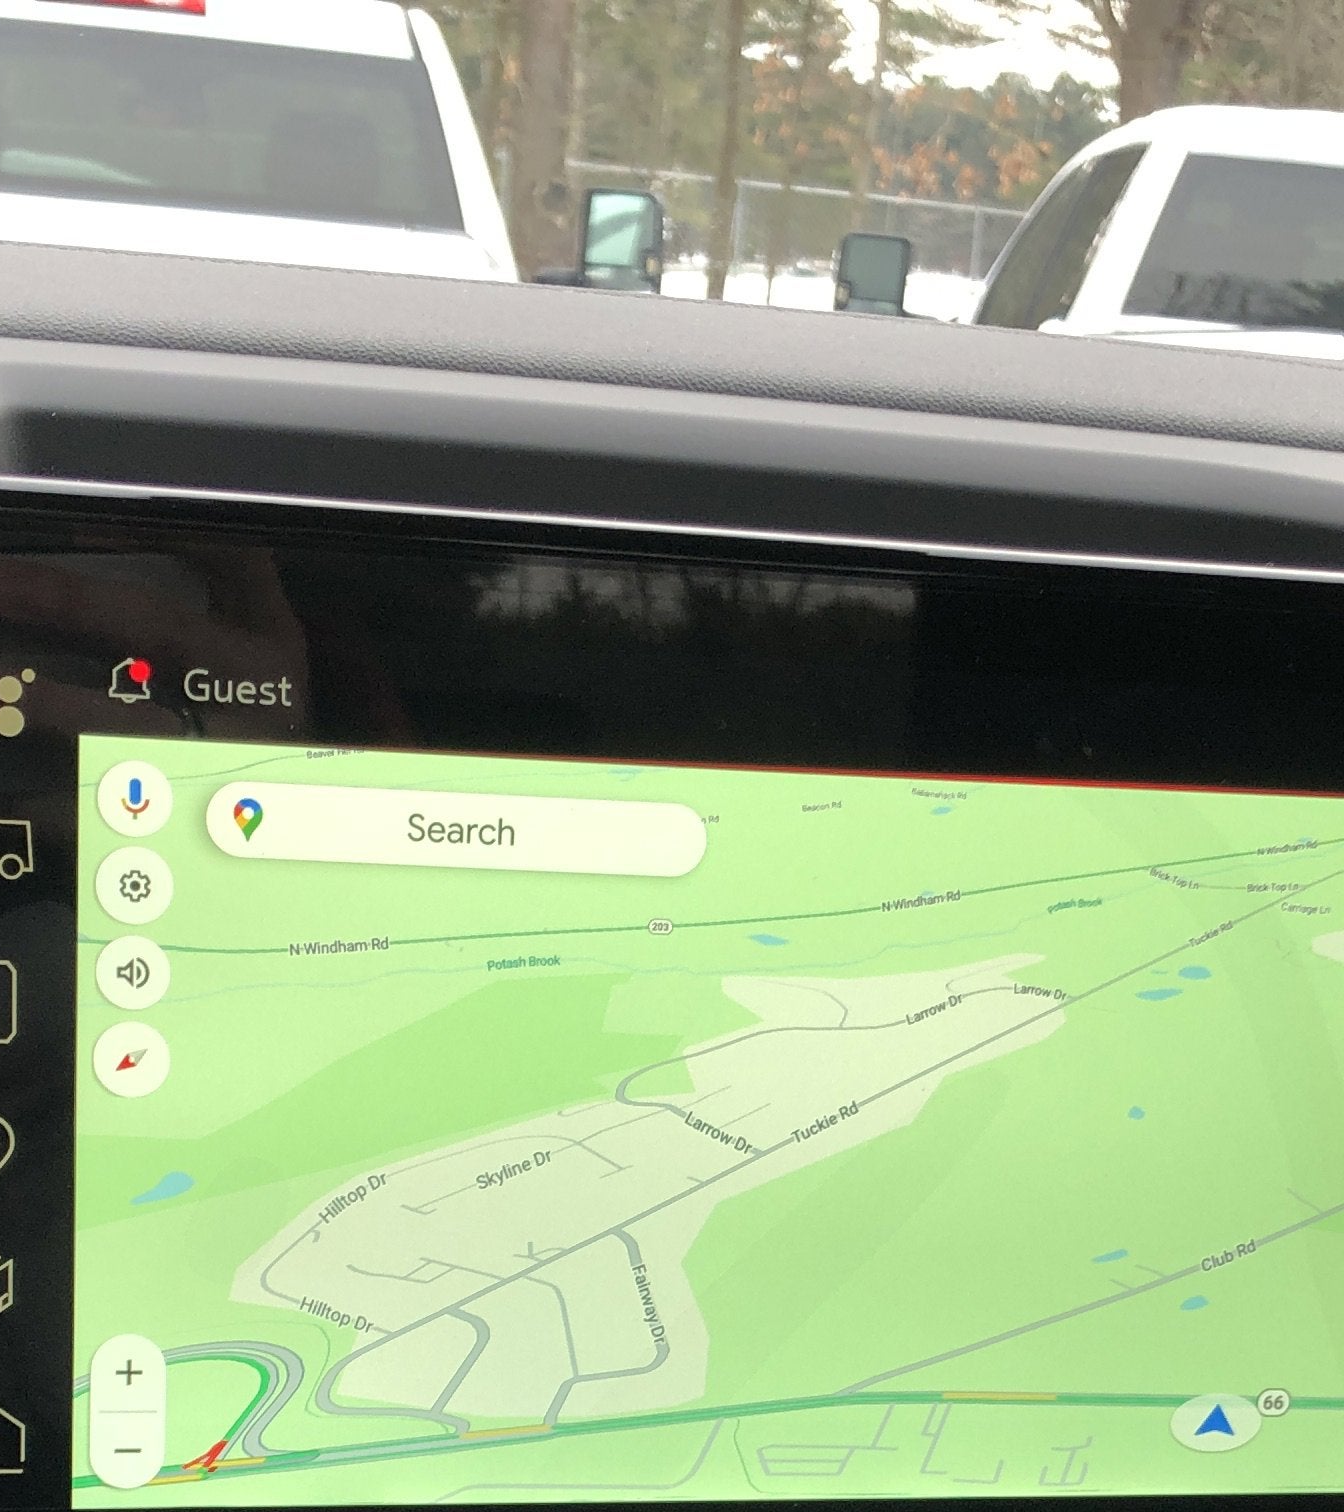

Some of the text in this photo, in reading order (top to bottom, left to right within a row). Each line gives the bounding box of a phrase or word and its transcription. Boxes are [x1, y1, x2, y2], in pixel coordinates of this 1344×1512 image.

[182, 668, 293, 707] Guest
[831, 801, 842, 809] Rd
[407, 814, 516, 847] Search
[708, 815, 719, 823] Rd
[1266, 842, 1304, 855] Windham
[1305, 839, 1318, 849] Rd
[1149, 867, 1172, 882] Brick
[1172, 874, 1187, 888] Top
[1247, 882, 1299, 893] Brick Top Ln
[882, 889, 961, 912] N Windham Rd
[1320, 906, 1331, 915] Ln
[651, 922, 669, 932] 203
[1188, 920, 1234, 948] Tuckie Rd
[289, 937, 389, 956] N Windham Rd
[487, 955, 561, 971] Potash Brook
[1014, 984, 1067, 1001] Larrow Dr
[906, 993, 963, 1025] Larrow Dr
[684, 1111, 753, 1155] Larrow Dr
[791, 1101, 859, 1143] Tuckie Rd
[476, 1150, 552, 1190] Skyline Dr
[318, 1173, 387, 1225] Hilltop Dr
[1201, 1239, 1256, 1271] Club Rd
[300, 1296, 374, 1333] Hilltop Dr
[632, 1264, 665, 1344] Fairway Dr
[1262, 1394, 1284, 1411] 66
